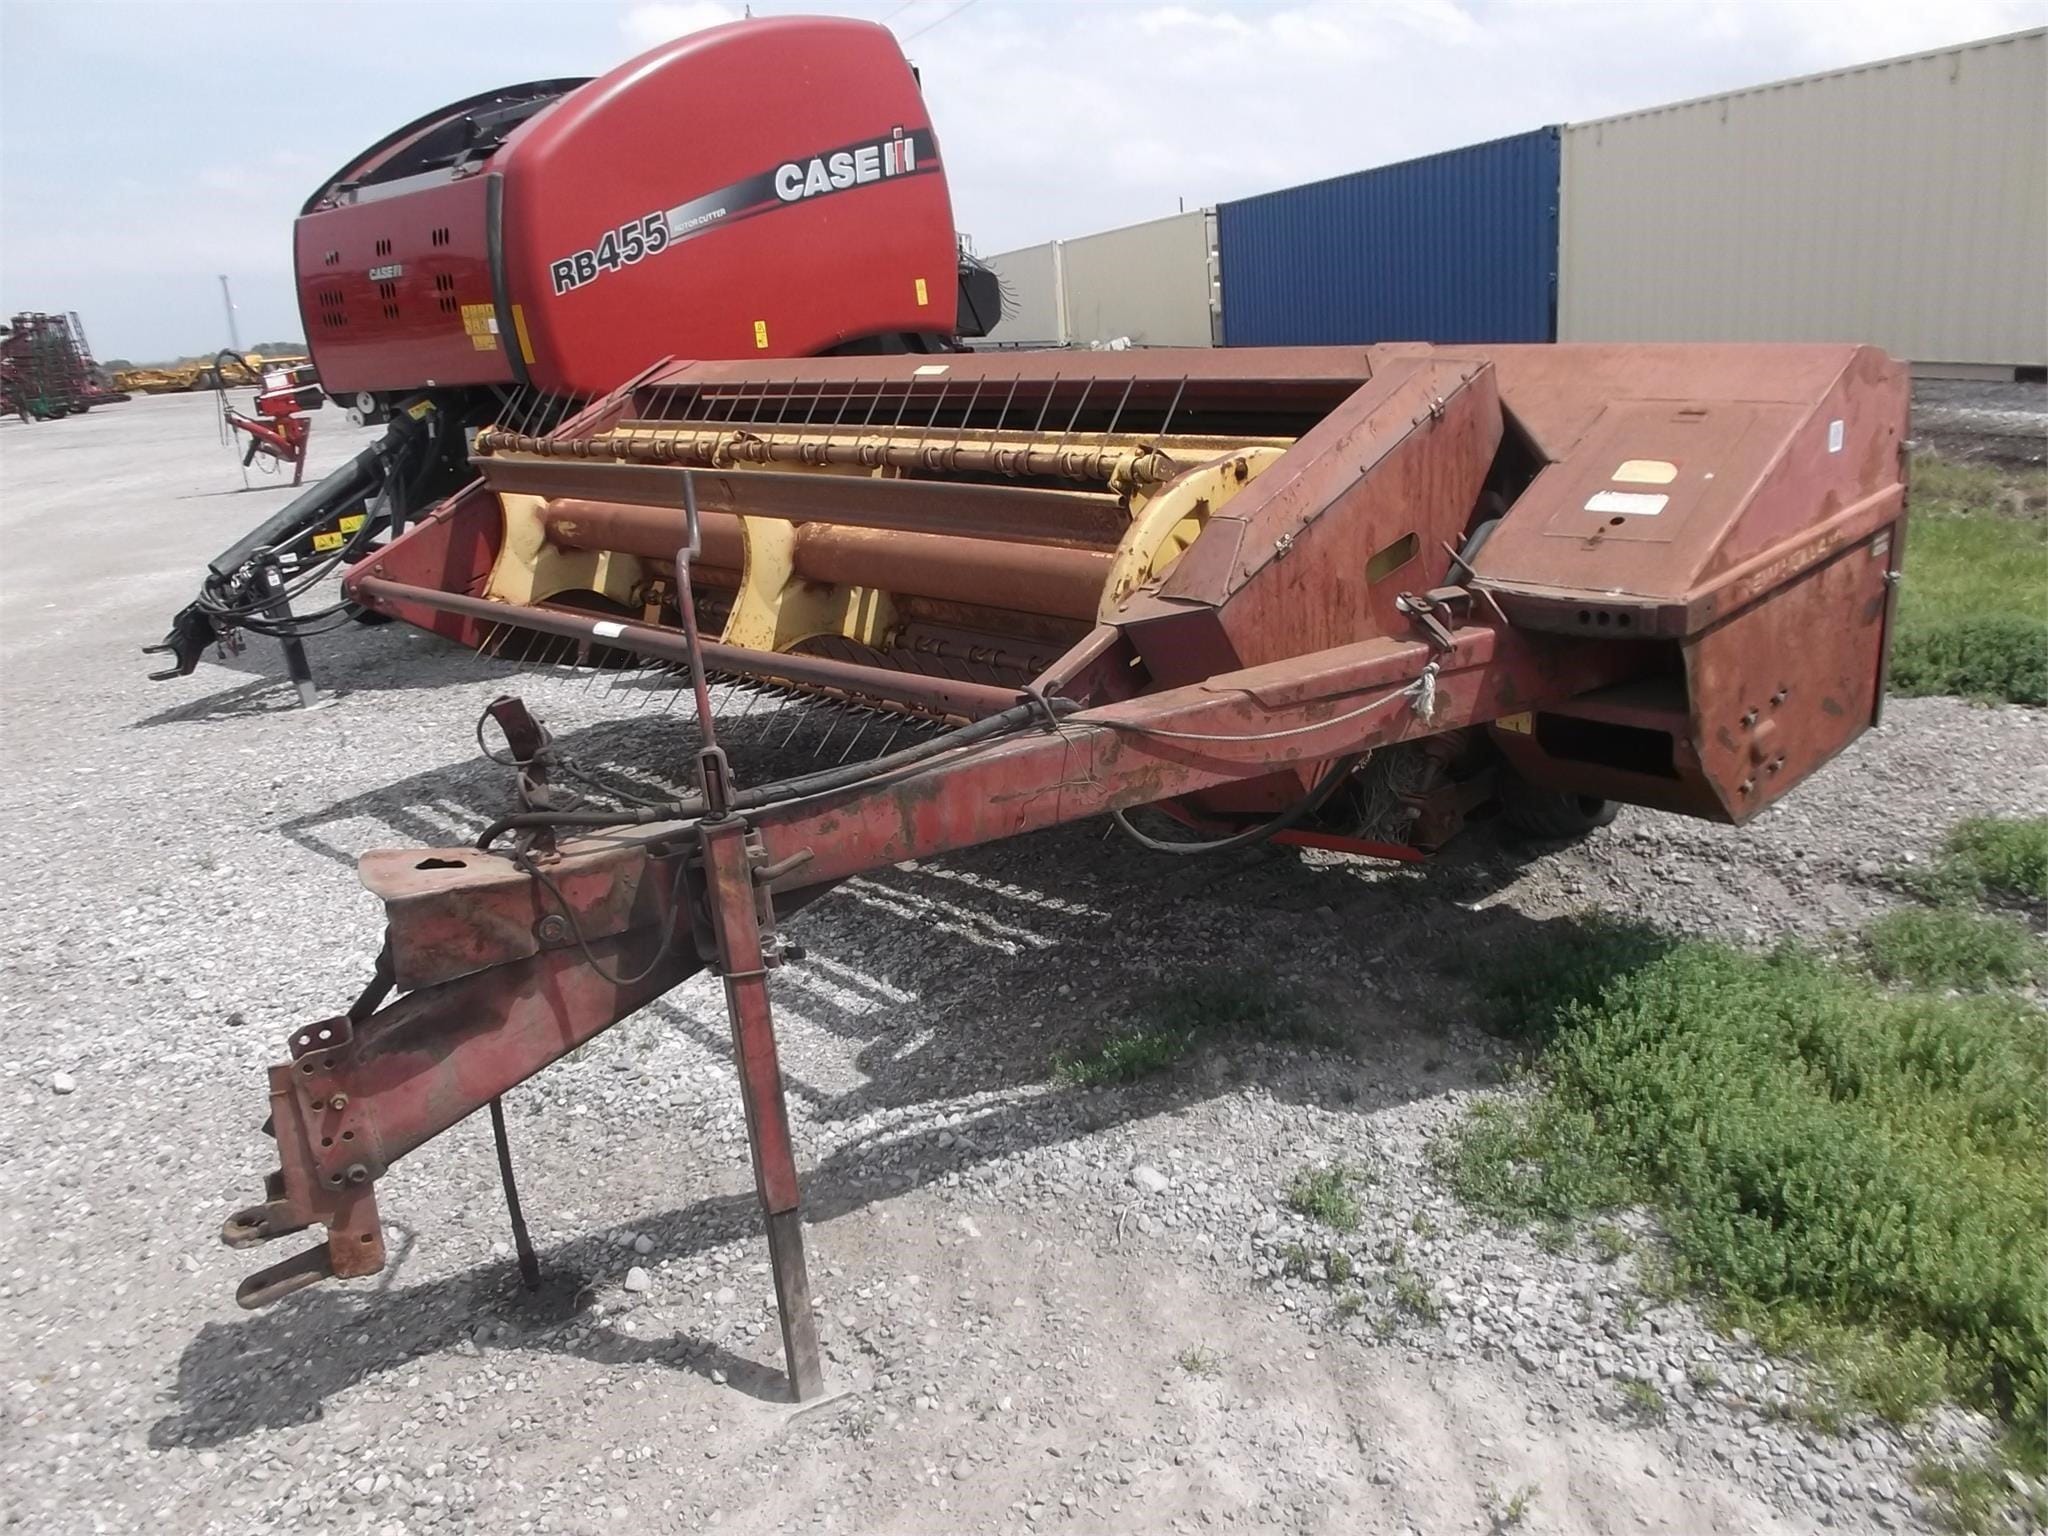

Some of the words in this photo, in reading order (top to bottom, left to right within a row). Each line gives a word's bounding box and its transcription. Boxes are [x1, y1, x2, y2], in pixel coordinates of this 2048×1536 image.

[775, 145, 880, 202] CASE
[698, 207, 727, 224] CUTTER
[551, 211, 669, 296] RB455
